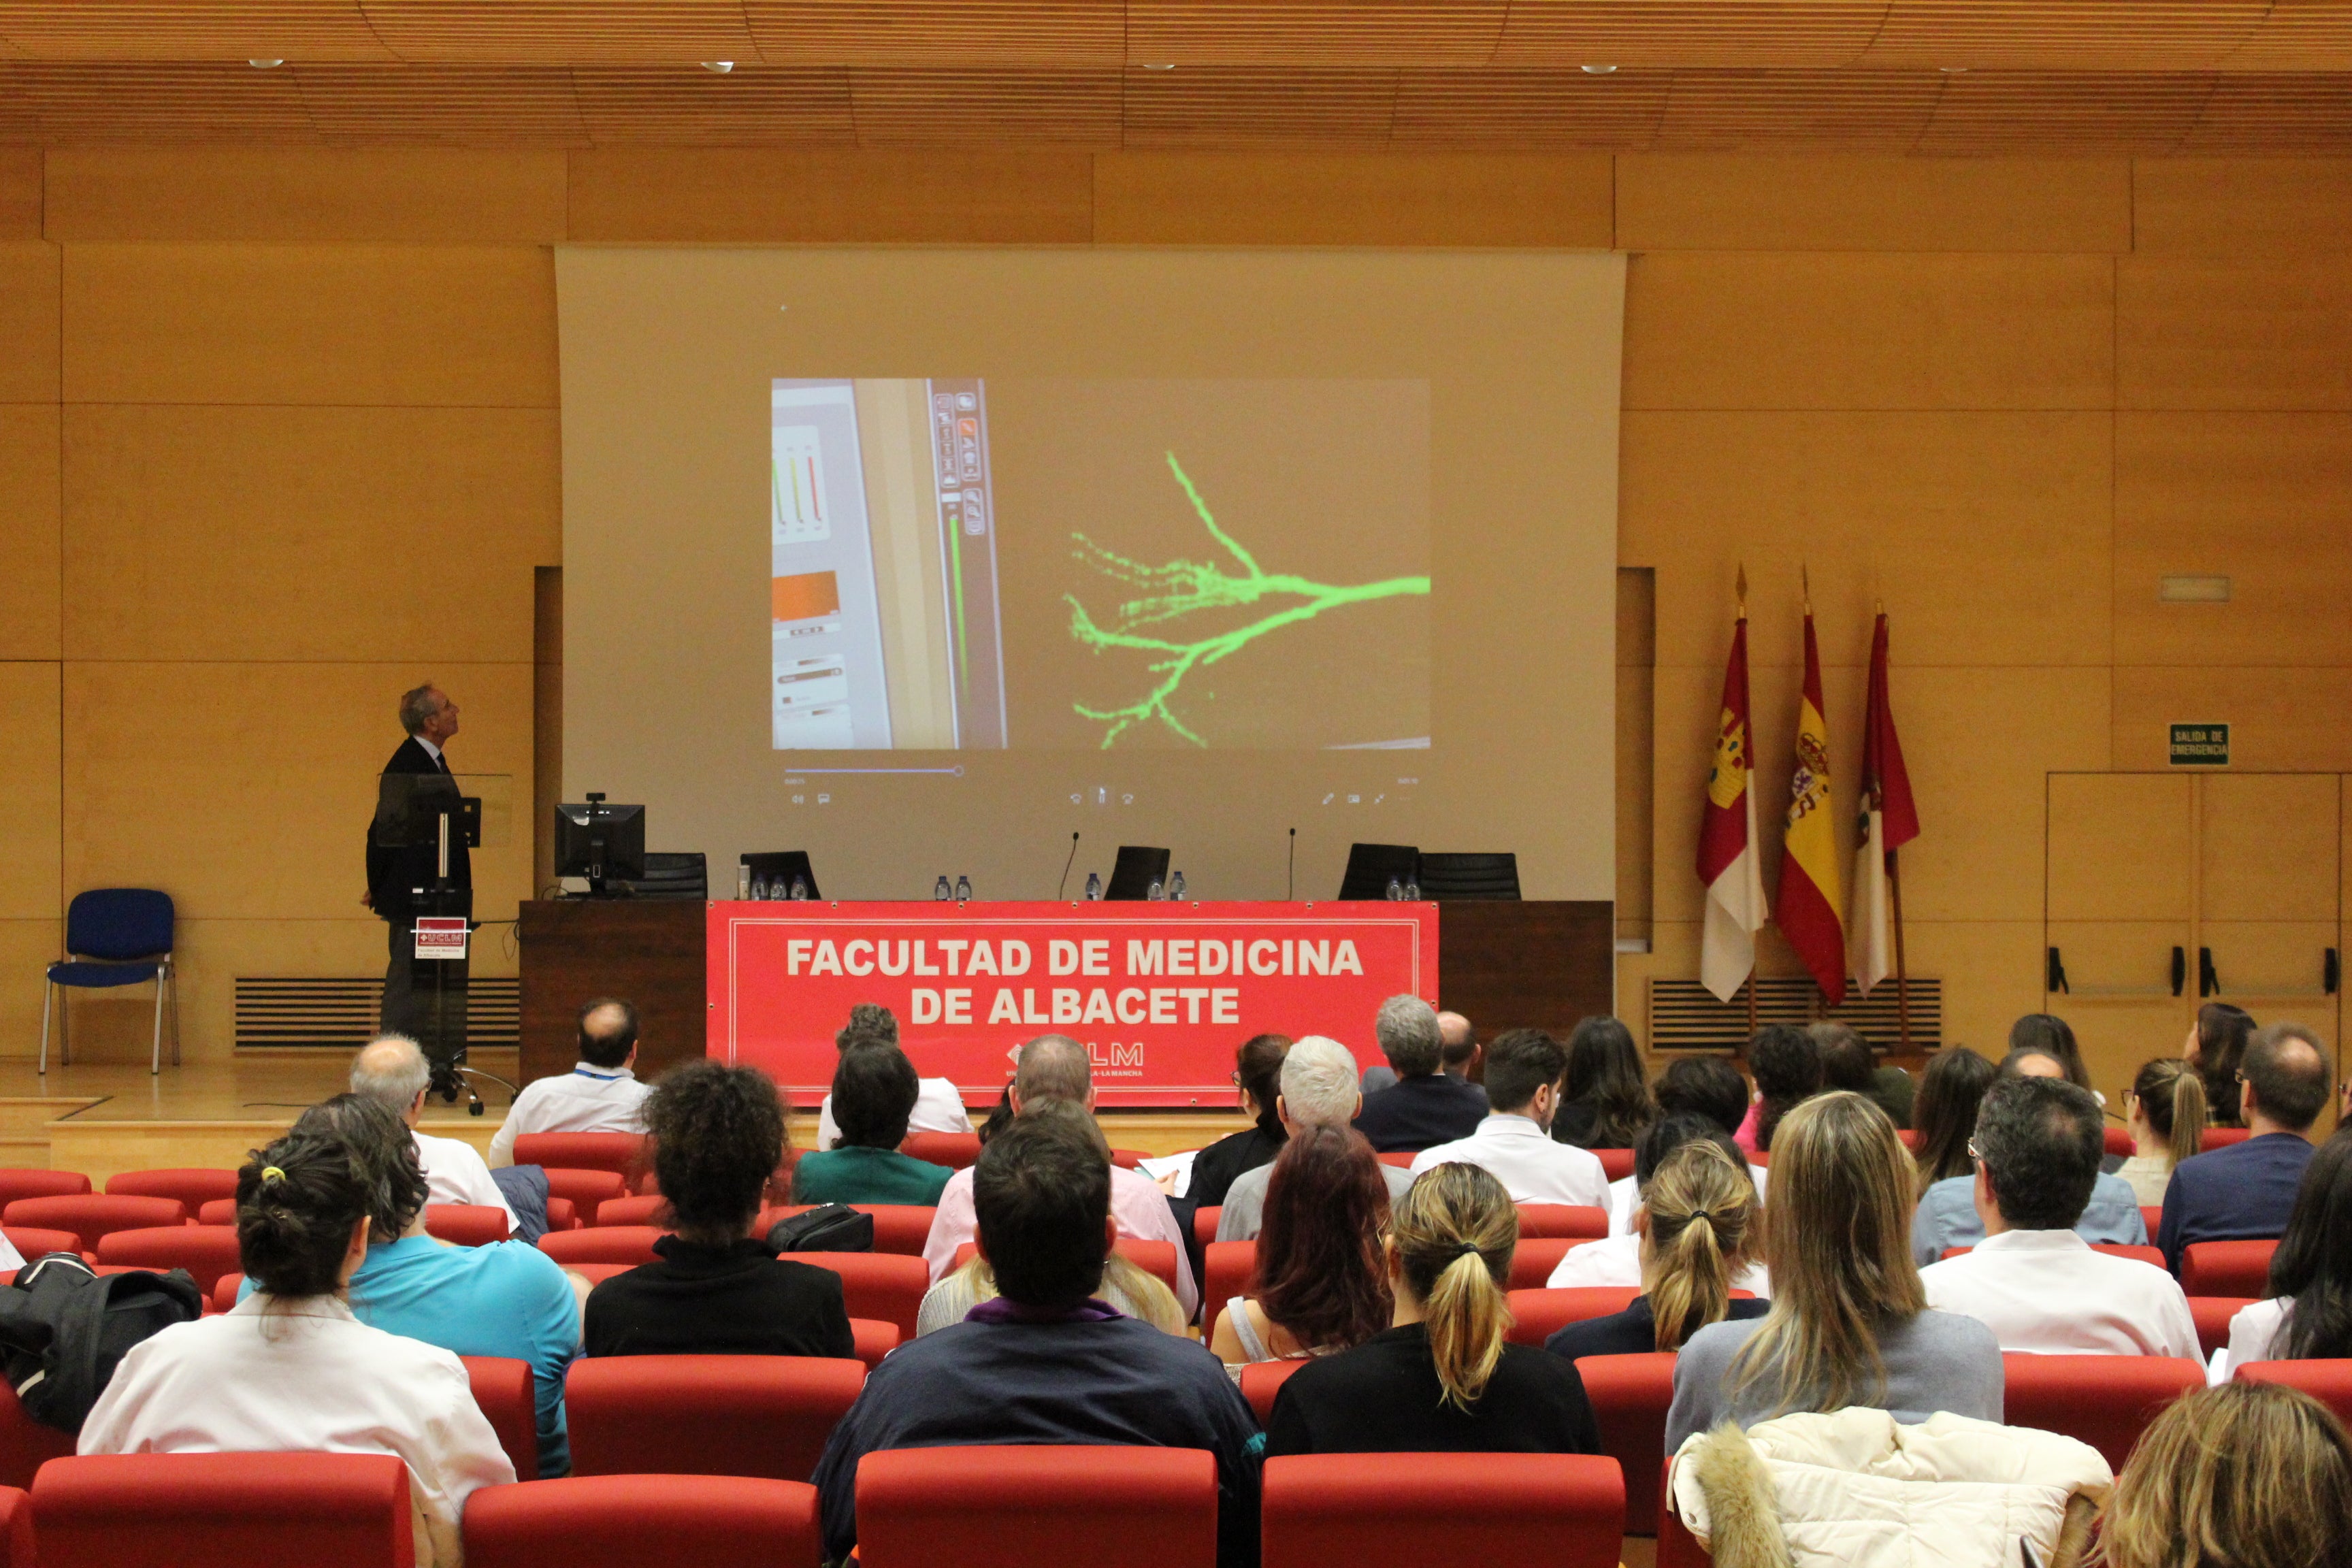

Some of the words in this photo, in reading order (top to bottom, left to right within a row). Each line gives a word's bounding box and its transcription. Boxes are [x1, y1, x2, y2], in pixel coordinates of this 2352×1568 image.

[2174, 730, 2207, 742] SALIDA
[2211, 730, 2223, 742] DE
[2171, 744, 2228, 755] EMERGENCIA
[427, 933, 463, 943] UCLM
[787, 938, 1032, 977] FACULTAD
[1048, 938, 1111, 977] DE
[1126, 938, 1364, 977] MEDICINA
[911, 987, 973, 1025] DE
[987, 987, 1240, 1025] ALBACETE
